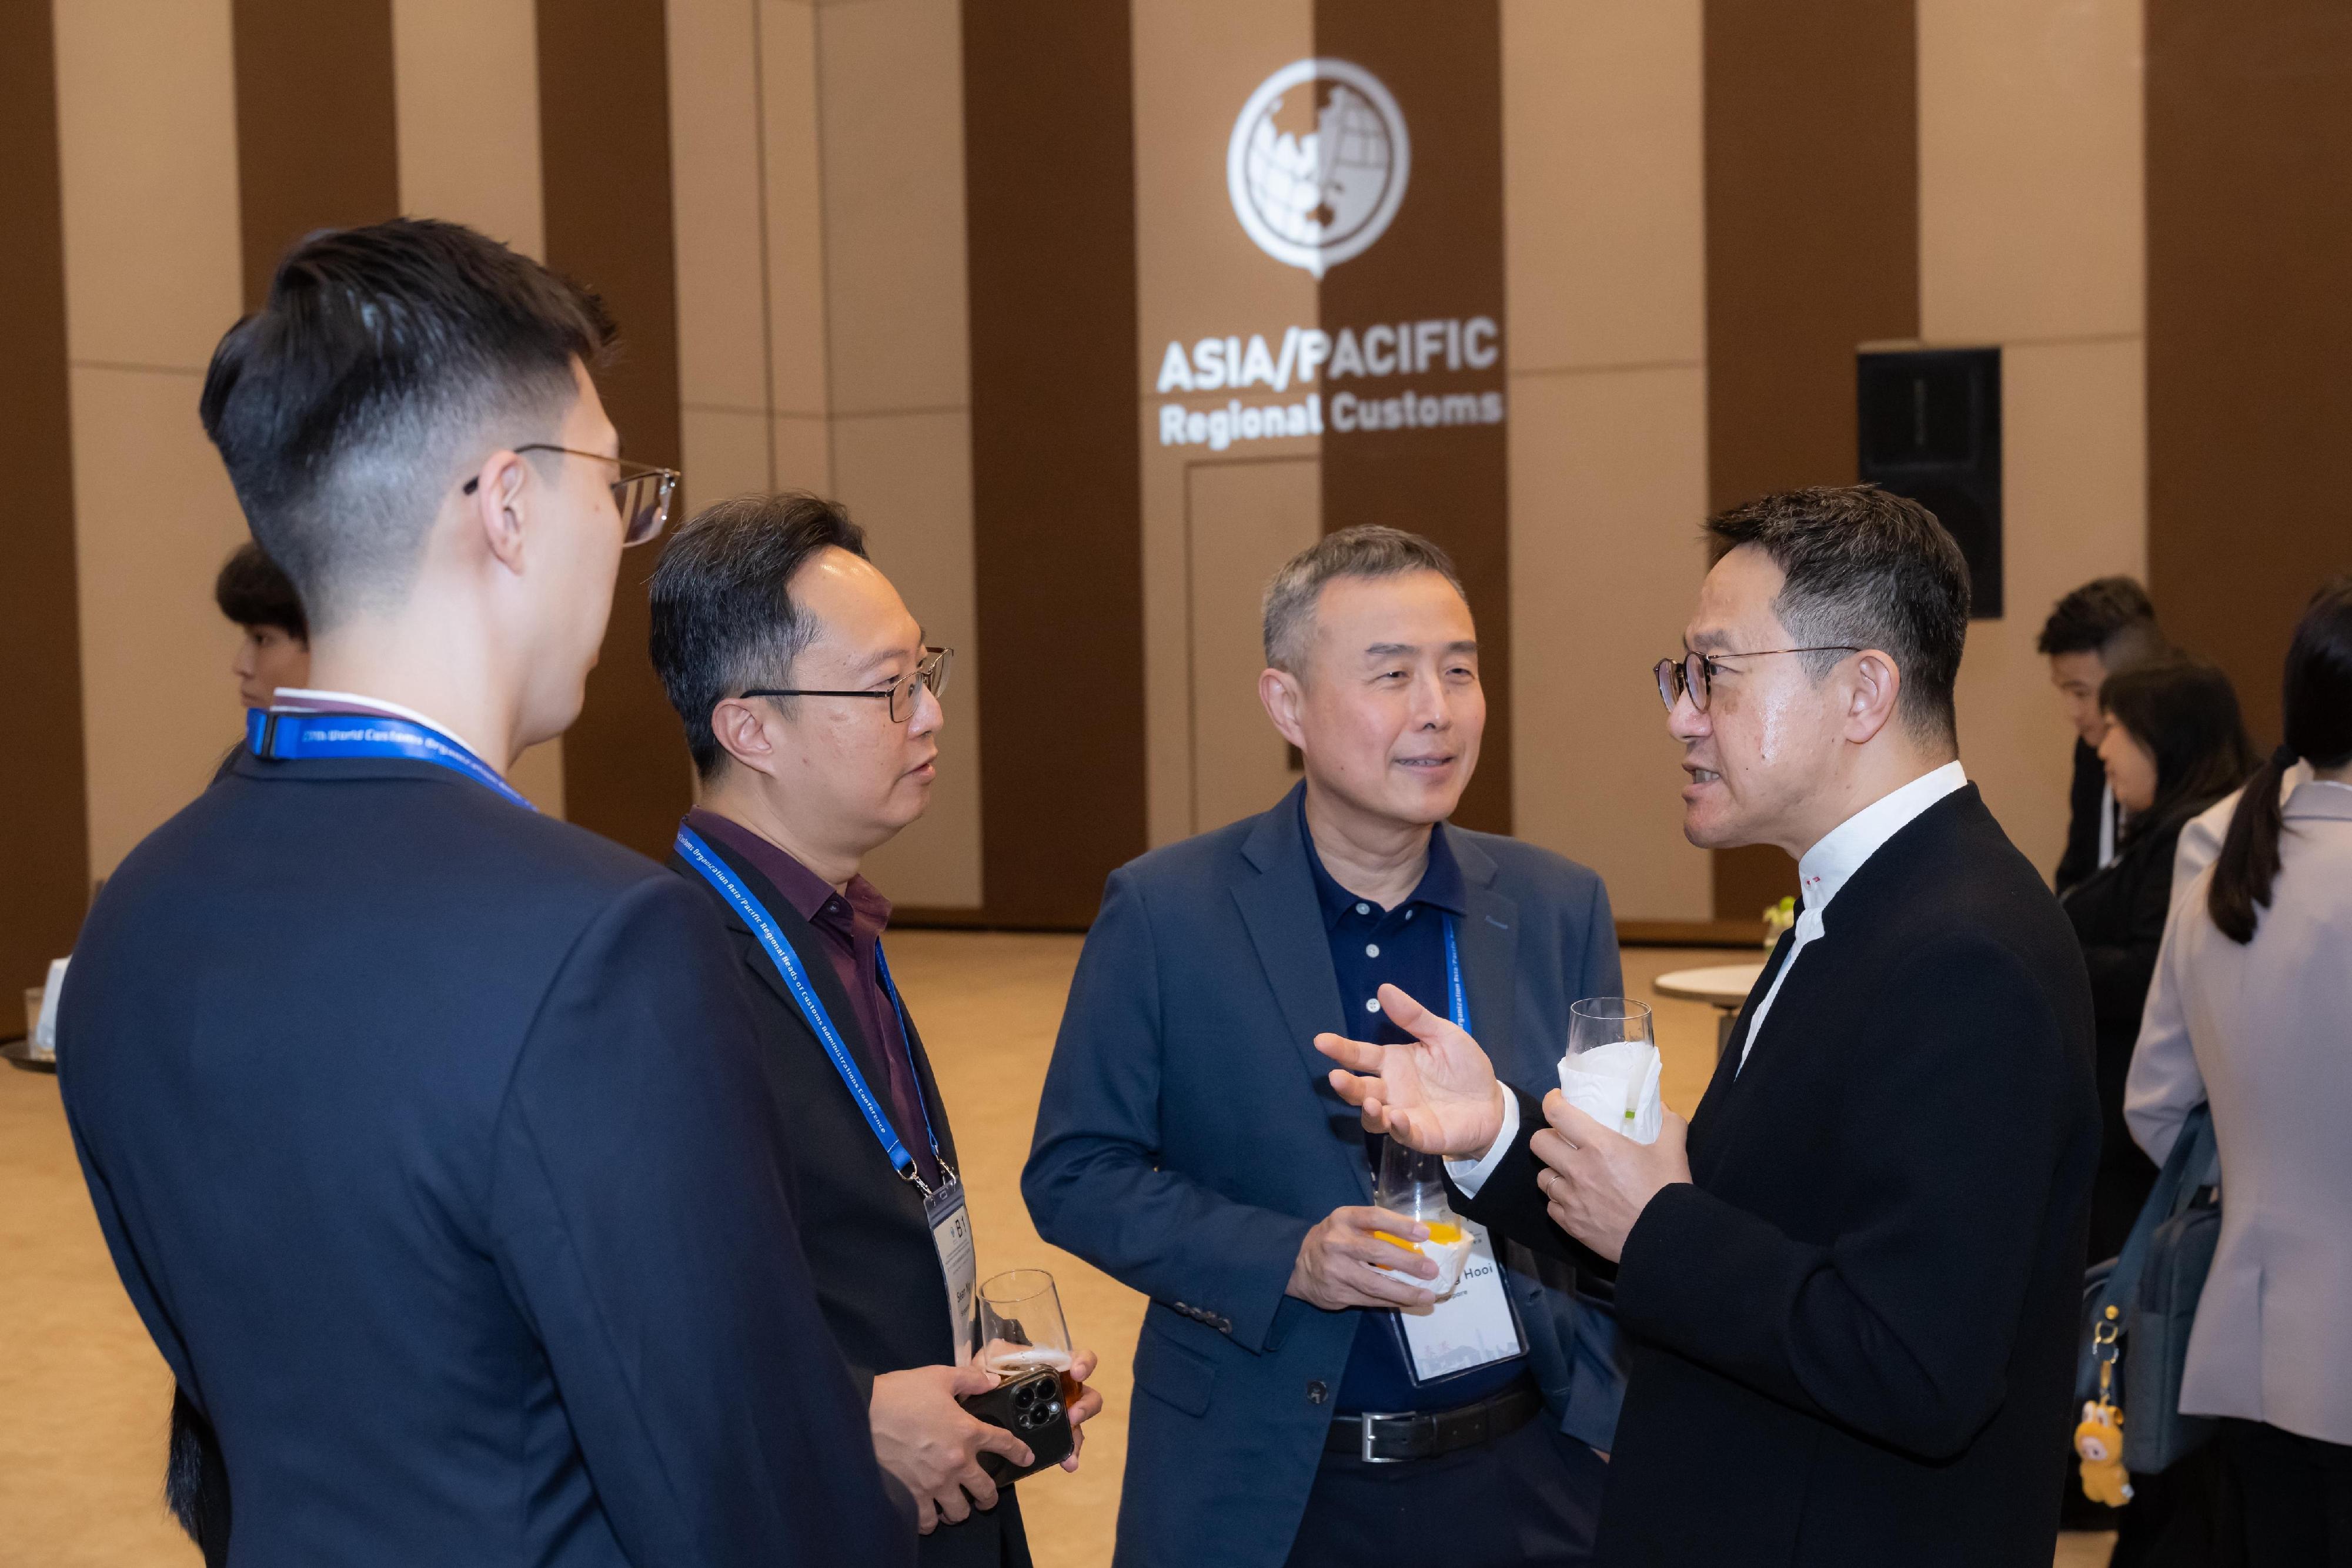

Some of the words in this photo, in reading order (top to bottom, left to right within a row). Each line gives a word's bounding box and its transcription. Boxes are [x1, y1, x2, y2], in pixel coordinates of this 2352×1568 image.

[1157, 316, 1498, 393] ASIA/PACIFIC
[1159, 394, 1324, 450] Regional
[1331, 390, 1503, 432] Customs
[365, 728, 423, 745] Customs
[693, 848, 729, 885] Organization
[727, 884, 762, 923] Asia/Pacific
[760, 922, 785, 957] Regional
[781, 955, 798, 981] Heads
[796, 981, 804, 991] of
[801, 991, 823, 1025] Customs
[821, 1025, 859, 1088] Administrations
[858, 1088, 886, 1134] Conference
[1455, 983, 1465, 1029] rganization
[955, 1215, 967, 1238] B1
[1464, 1262, 1494, 1279] Hooi
